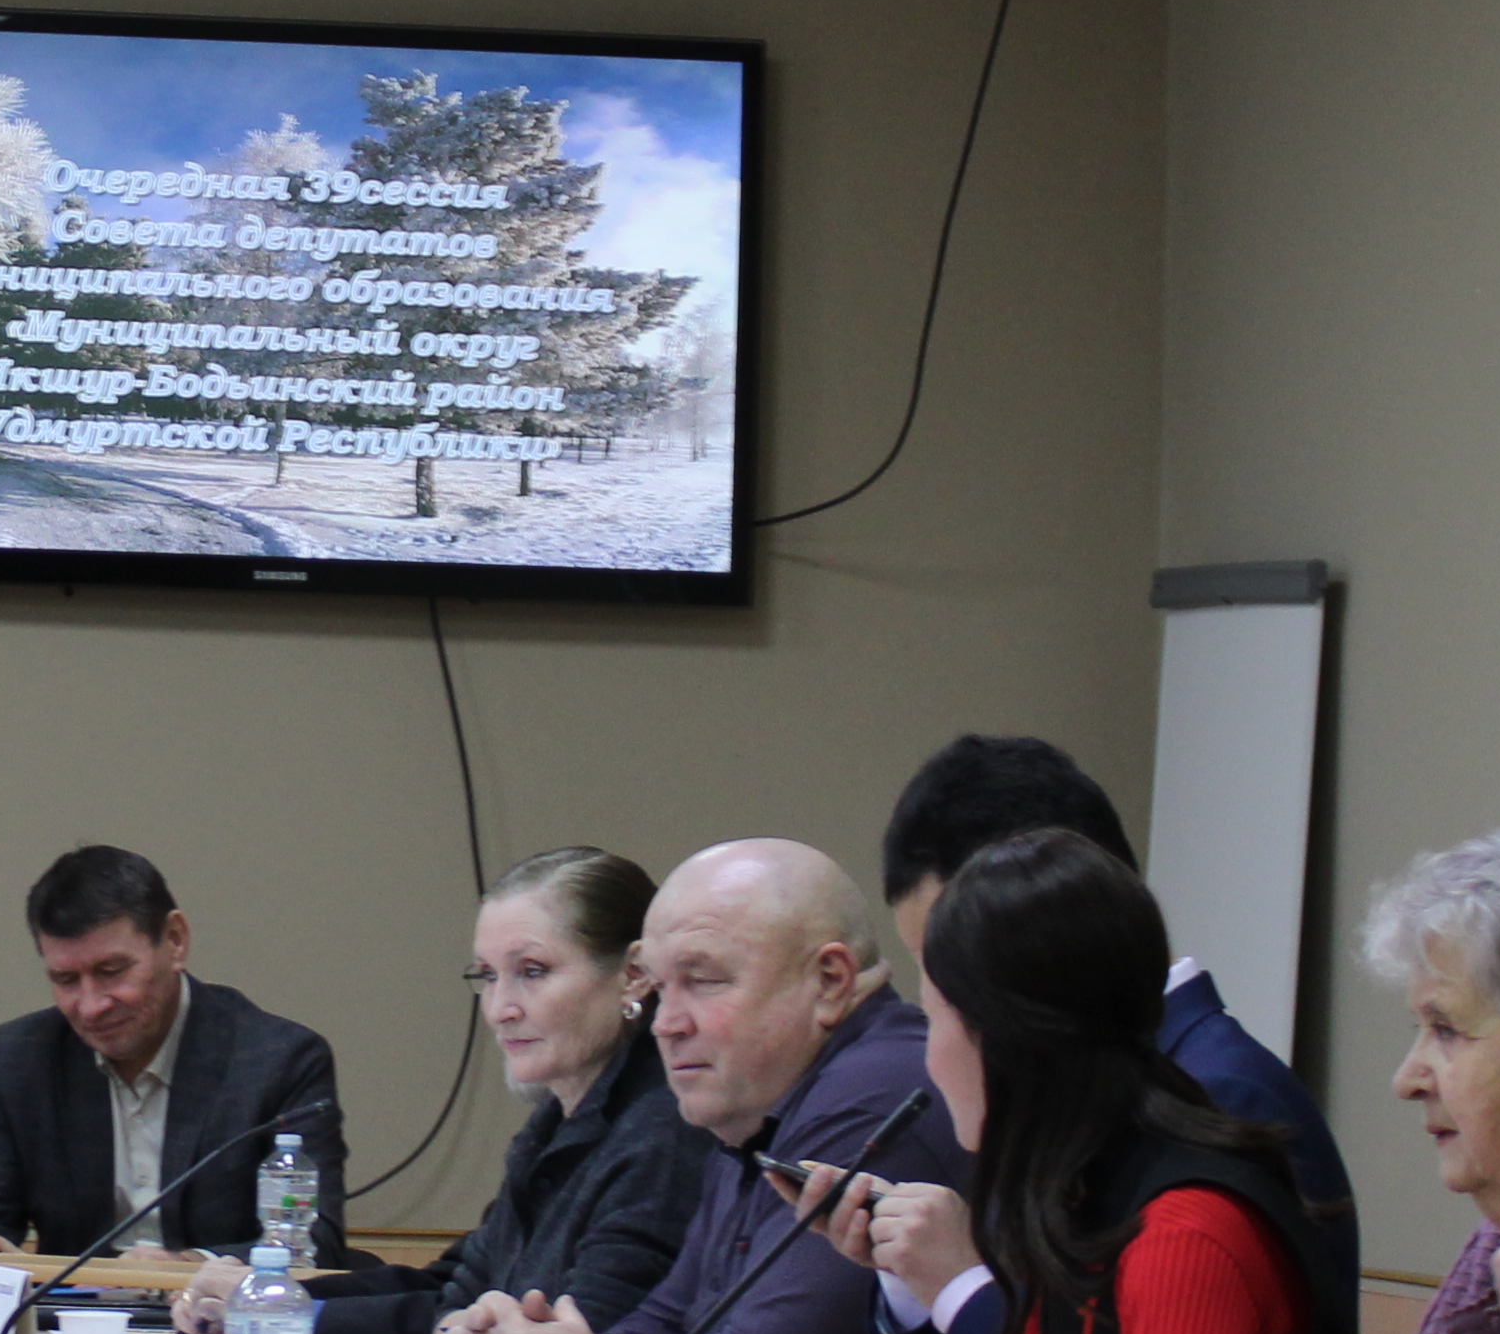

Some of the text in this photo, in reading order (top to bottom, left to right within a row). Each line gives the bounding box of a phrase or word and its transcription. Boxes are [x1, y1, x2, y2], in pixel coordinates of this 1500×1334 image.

[43, 159, 511, 210] Очередная 39сессия
[50, 209, 500, 262] Совета депутатов
[321, 268, 617, 314] образования
[4, 308, 542, 368] «Муниципальный округ
[420, 372, 567, 417] район
[276, 419, 564, 466] Республики»
